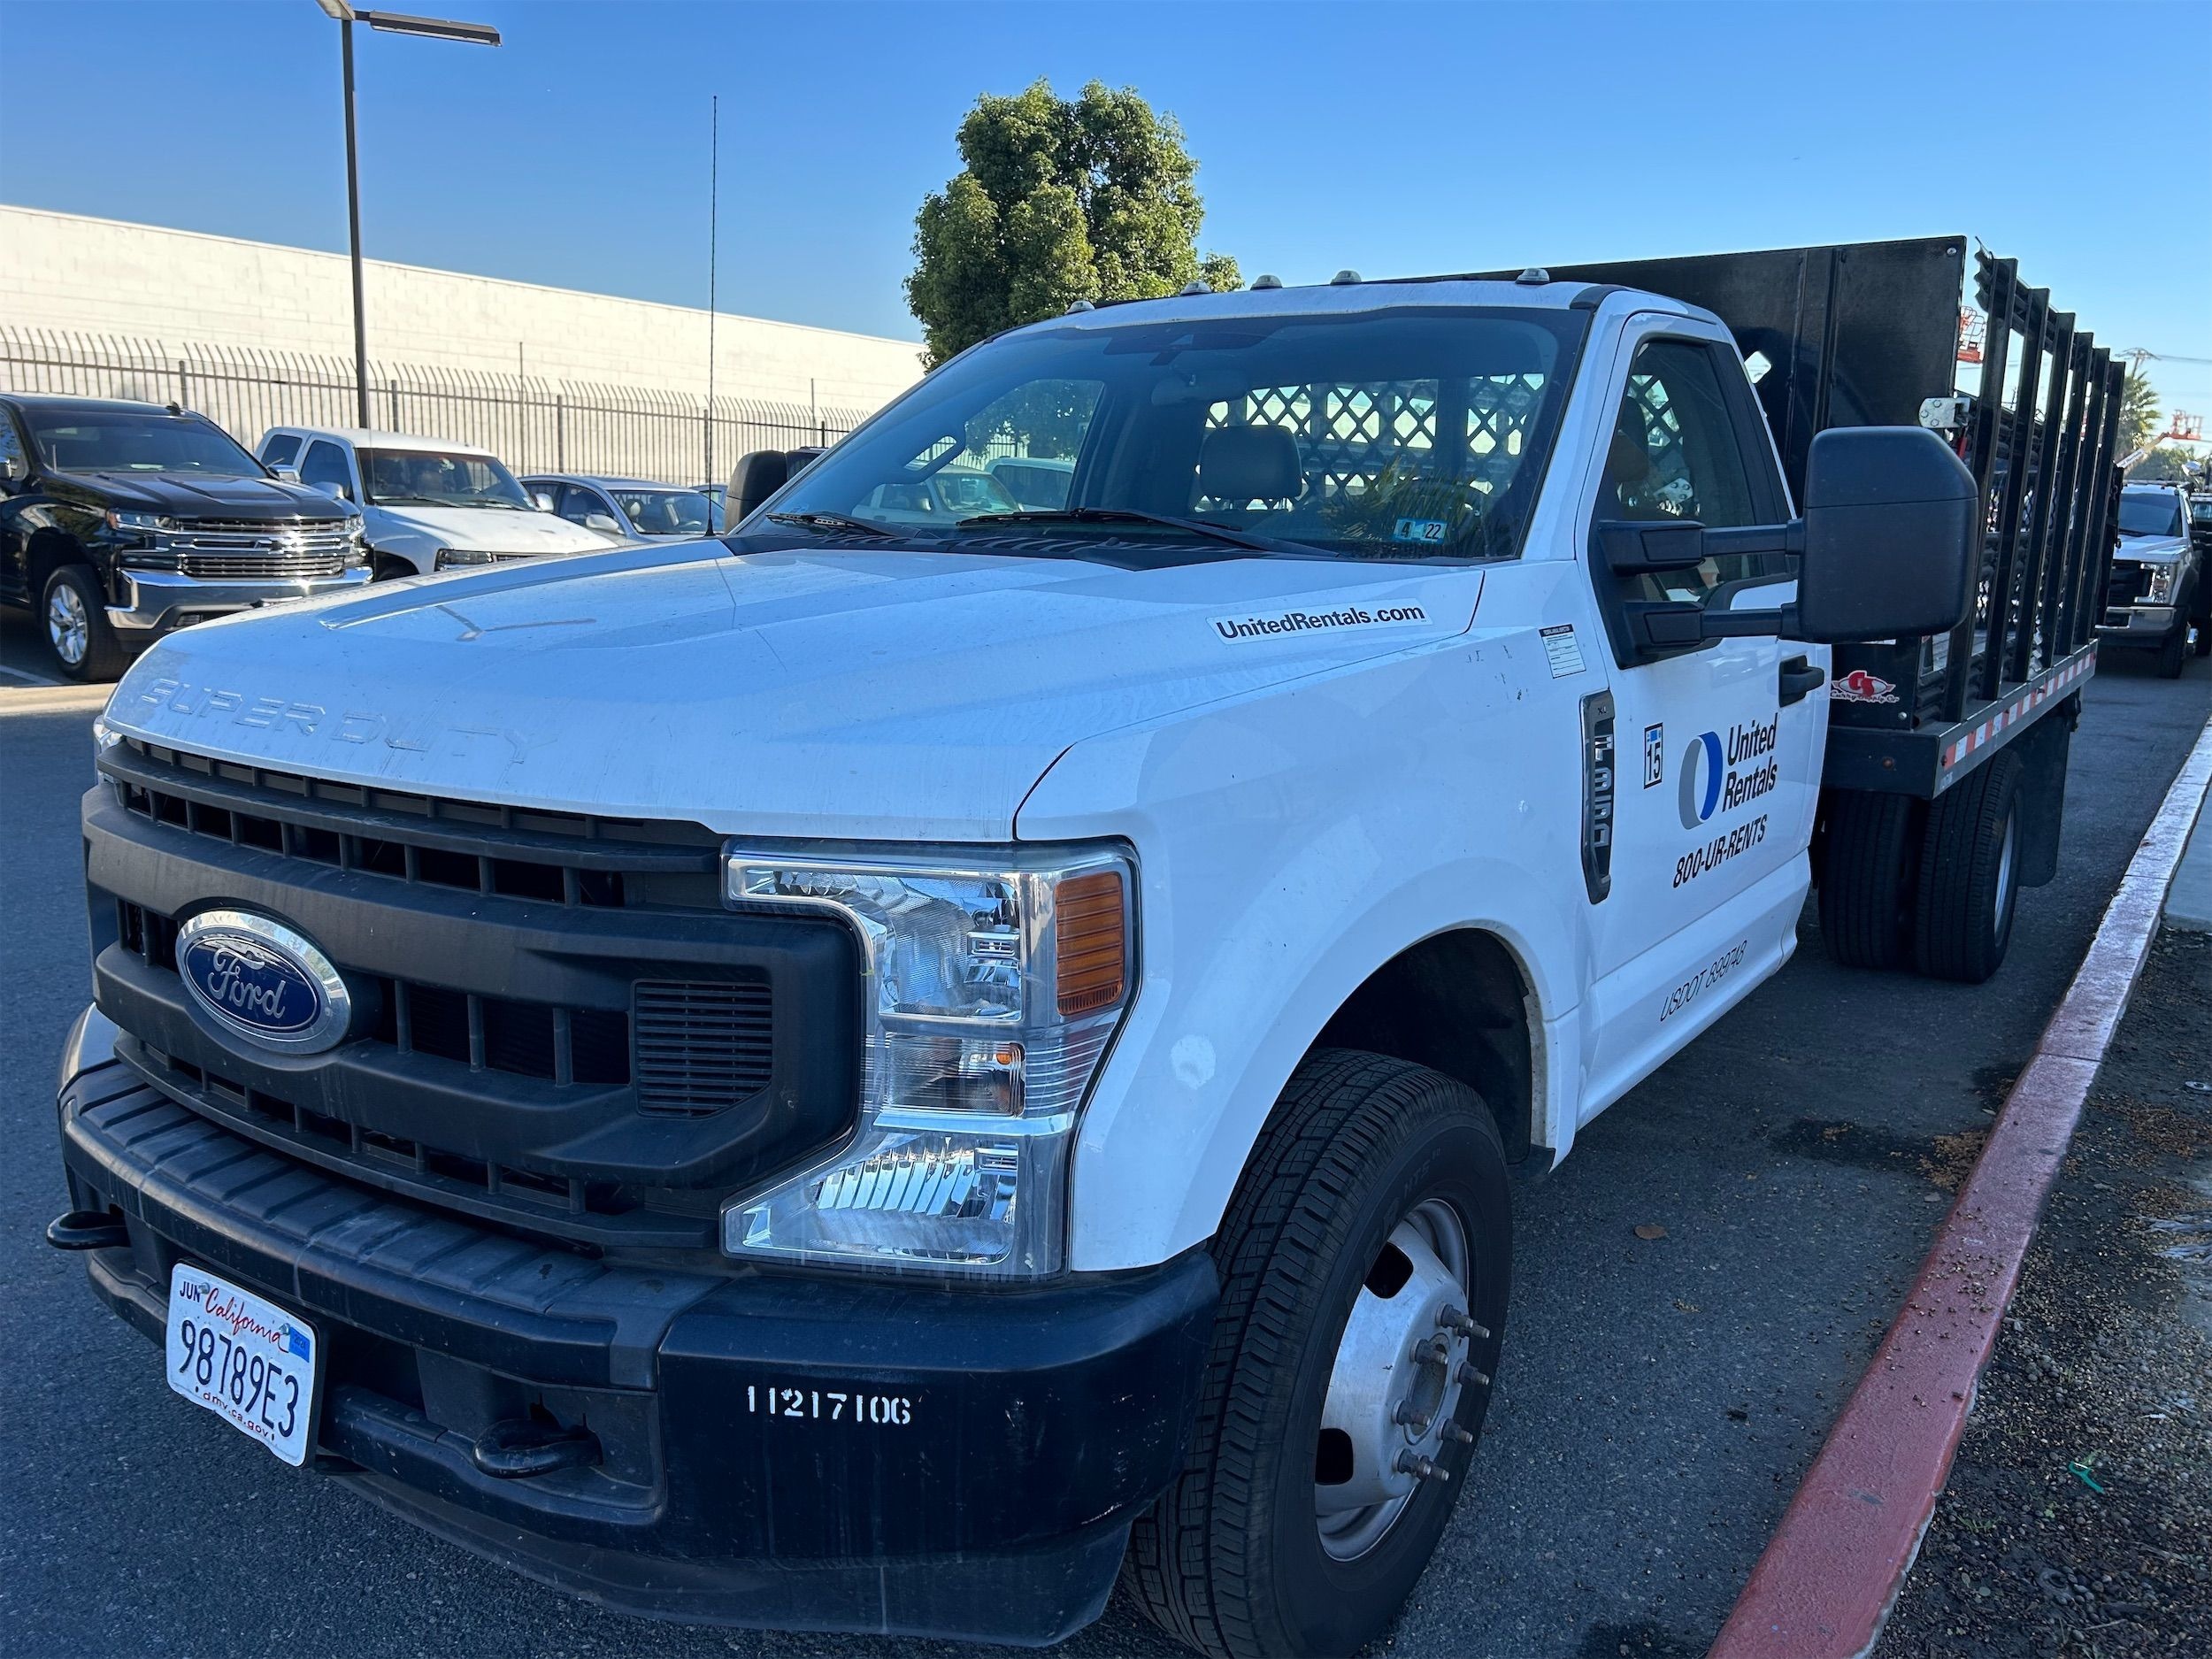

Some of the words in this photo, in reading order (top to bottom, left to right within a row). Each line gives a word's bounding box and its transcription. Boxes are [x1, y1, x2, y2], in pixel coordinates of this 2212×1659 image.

[1425, 523, 1441, 540] 22
[1216, 605, 1425, 639] UnitedRentals.com
[140, 679, 326, 737] SUPER
[1647, 741, 1661, 782] 15
[1728, 712, 1778, 766] United
[1722, 756, 1778, 814] Rentals
[1672, 814, 1768, 888] 800-UR-RENTS
[207, 947, 287, 1019] Ford
[1660, 969, 1708, 1022] USDOT
[180, 1281, 201, 1303] JUN
[205, 1287, 289, 1354] California
[180, 1319, 299, 1438] 98789E3
[748, 1386, 910, 1425] 11217106
[203, 1391, 269, 1439] dmv.ca.gov
